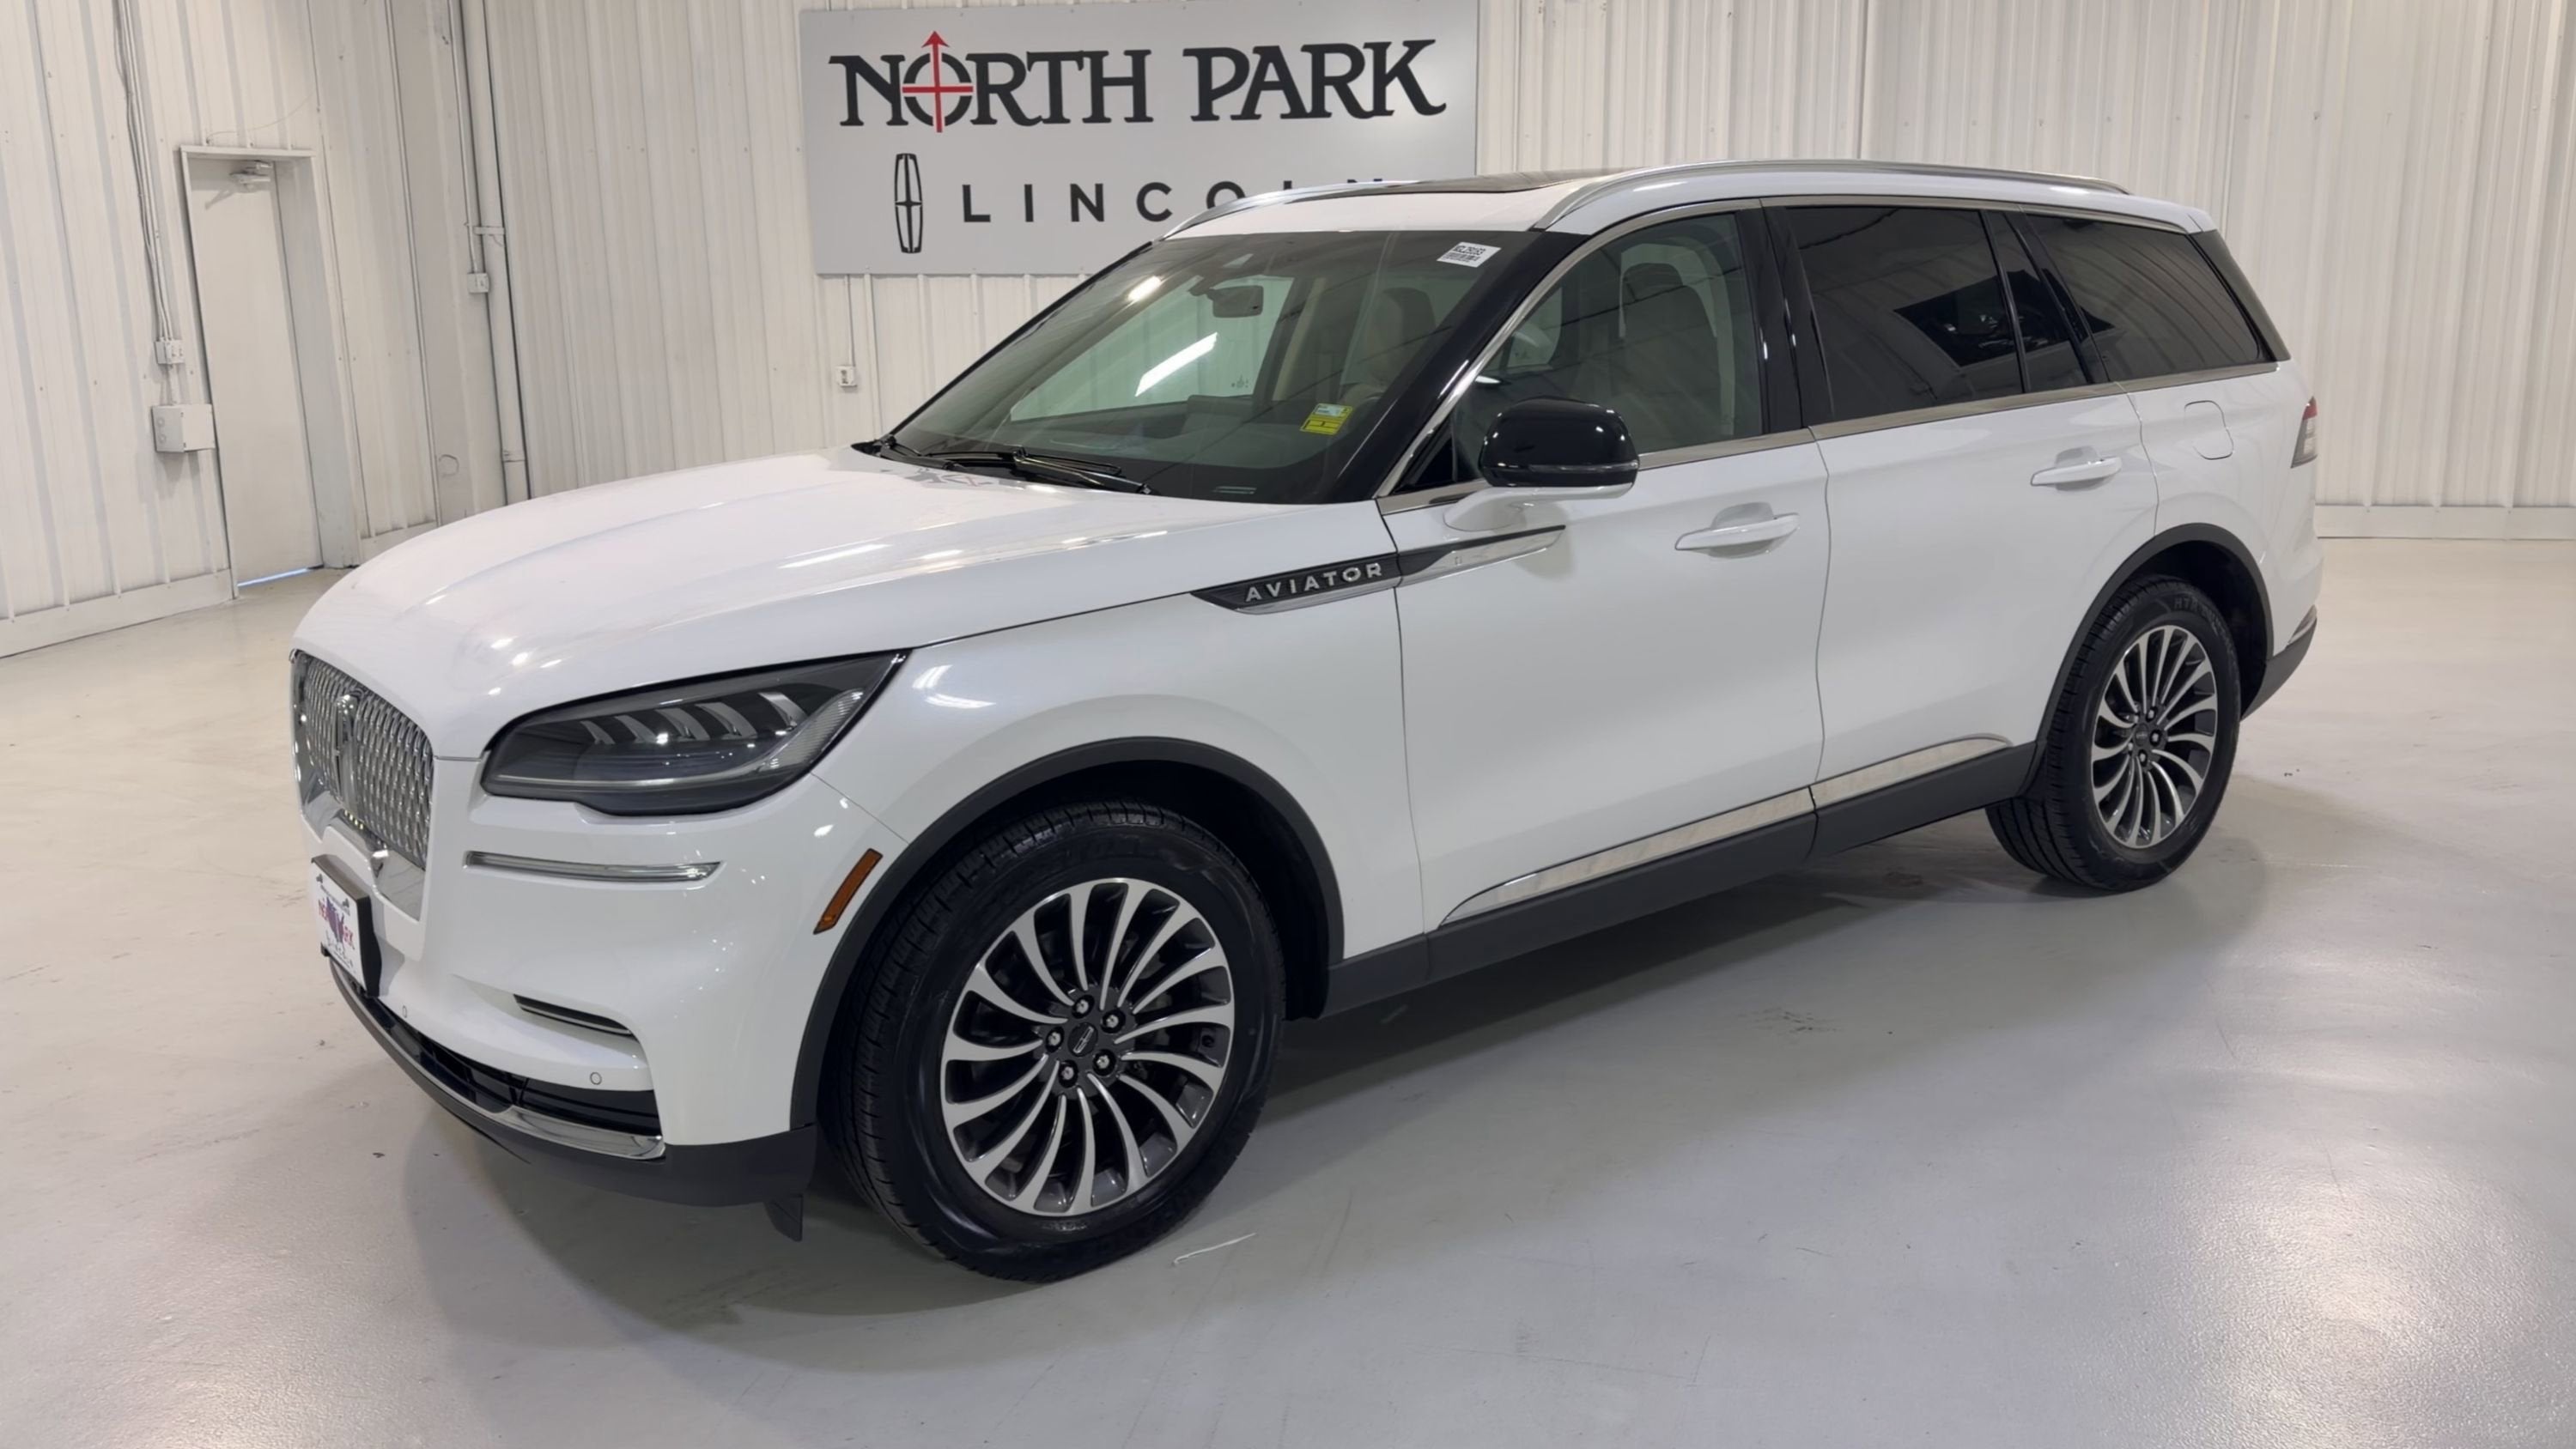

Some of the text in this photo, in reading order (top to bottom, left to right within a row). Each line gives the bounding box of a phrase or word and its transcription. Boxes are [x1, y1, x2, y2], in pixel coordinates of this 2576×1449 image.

[829, 39, 1447, 127] NORTH PARK
[963, 178, 1382, 222] LINCO
[1246, 562, 1382, 602] AVIATOR
